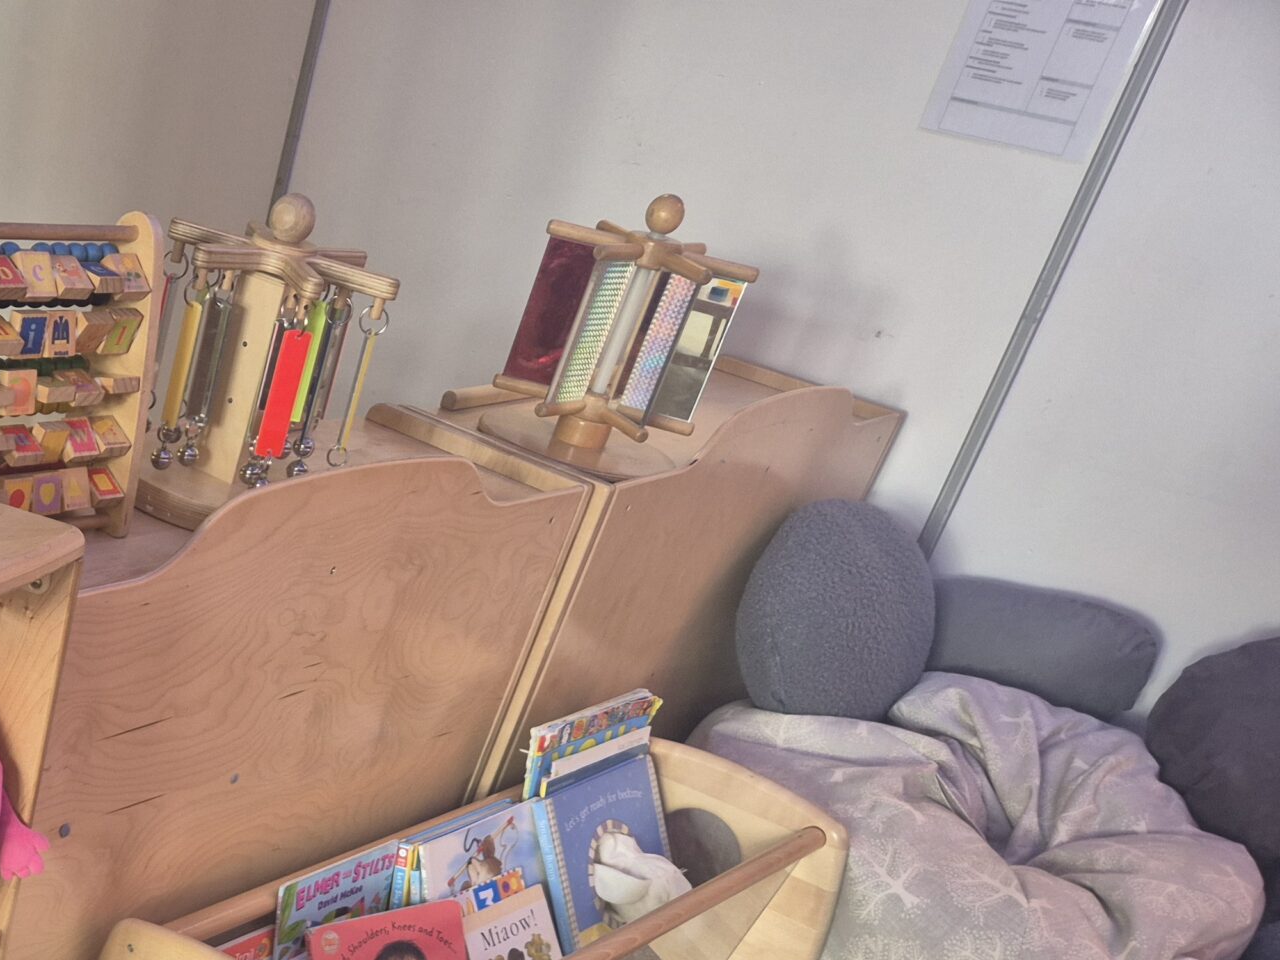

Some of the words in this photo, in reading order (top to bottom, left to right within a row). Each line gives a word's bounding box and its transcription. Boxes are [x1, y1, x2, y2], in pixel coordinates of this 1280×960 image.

[32, 264, 45, 282] c
[26, 323, 37, 349] i
[564, 815, 580, 832] Let's
[580, 806, 590, 822] get
[590, 796, 607, 812] ready
[607, 790, 617, 804] for
[617, 788, 643, 801] bedtime
[295, 871, 340, 912] ELMER
[352, 853, 397, 883] STILTS
[317, 893, 339, 911] David
[340, 885, 364, 900] McKee
[347, 926, 390, 956] Shoulders,
[391, 920, 416, 933] Knees
[417, 925, 434, 937] and
[480, 908, 538, 951] Miaow!
